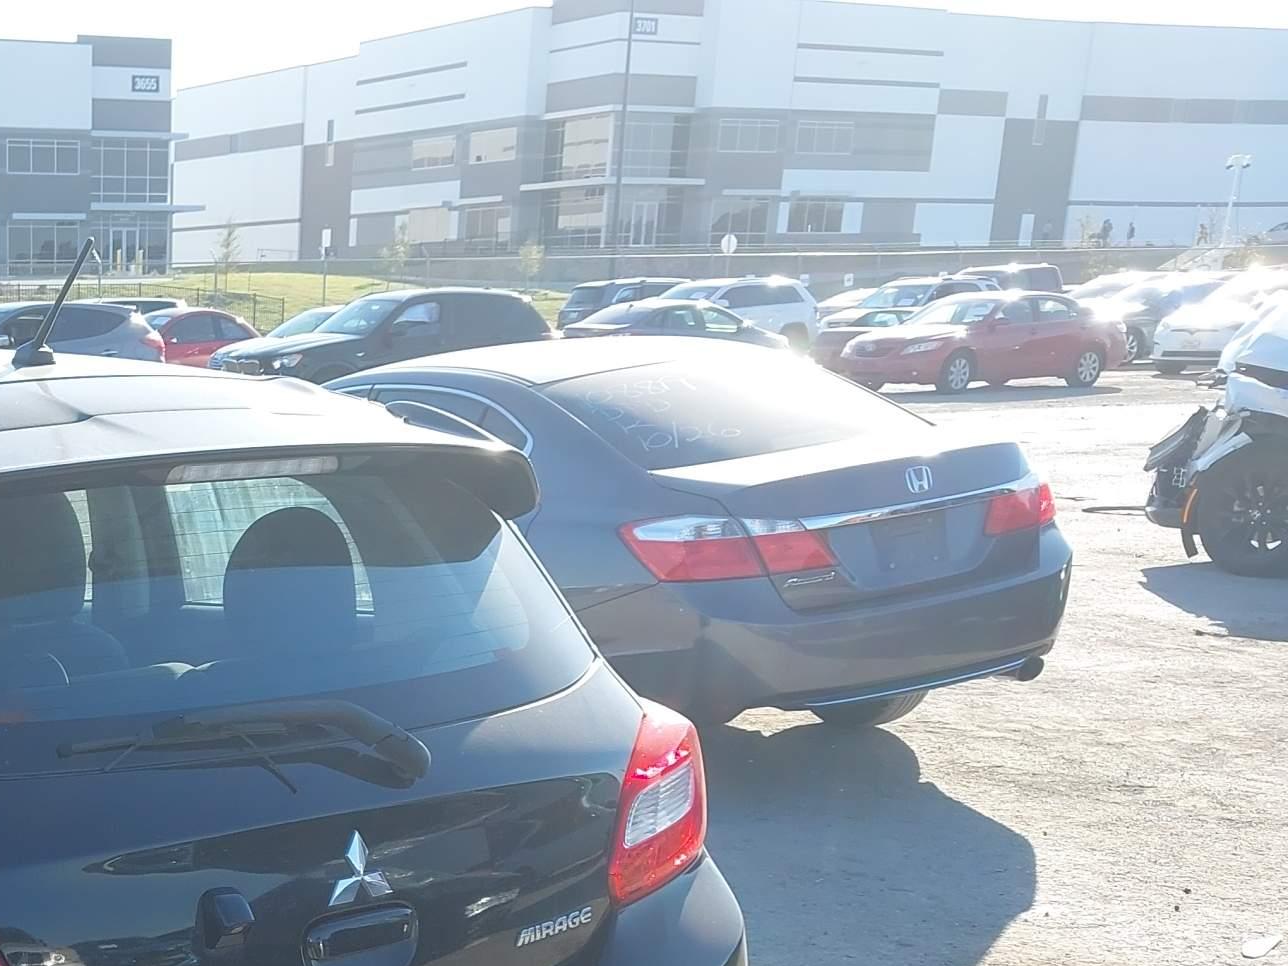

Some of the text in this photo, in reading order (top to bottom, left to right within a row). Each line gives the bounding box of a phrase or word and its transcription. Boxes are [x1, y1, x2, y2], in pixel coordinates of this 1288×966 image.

[636, 20, 656, 32] 3701
[134, 77, 157, 90] 3655
[516, 906, 592, 947] MIRAGE
